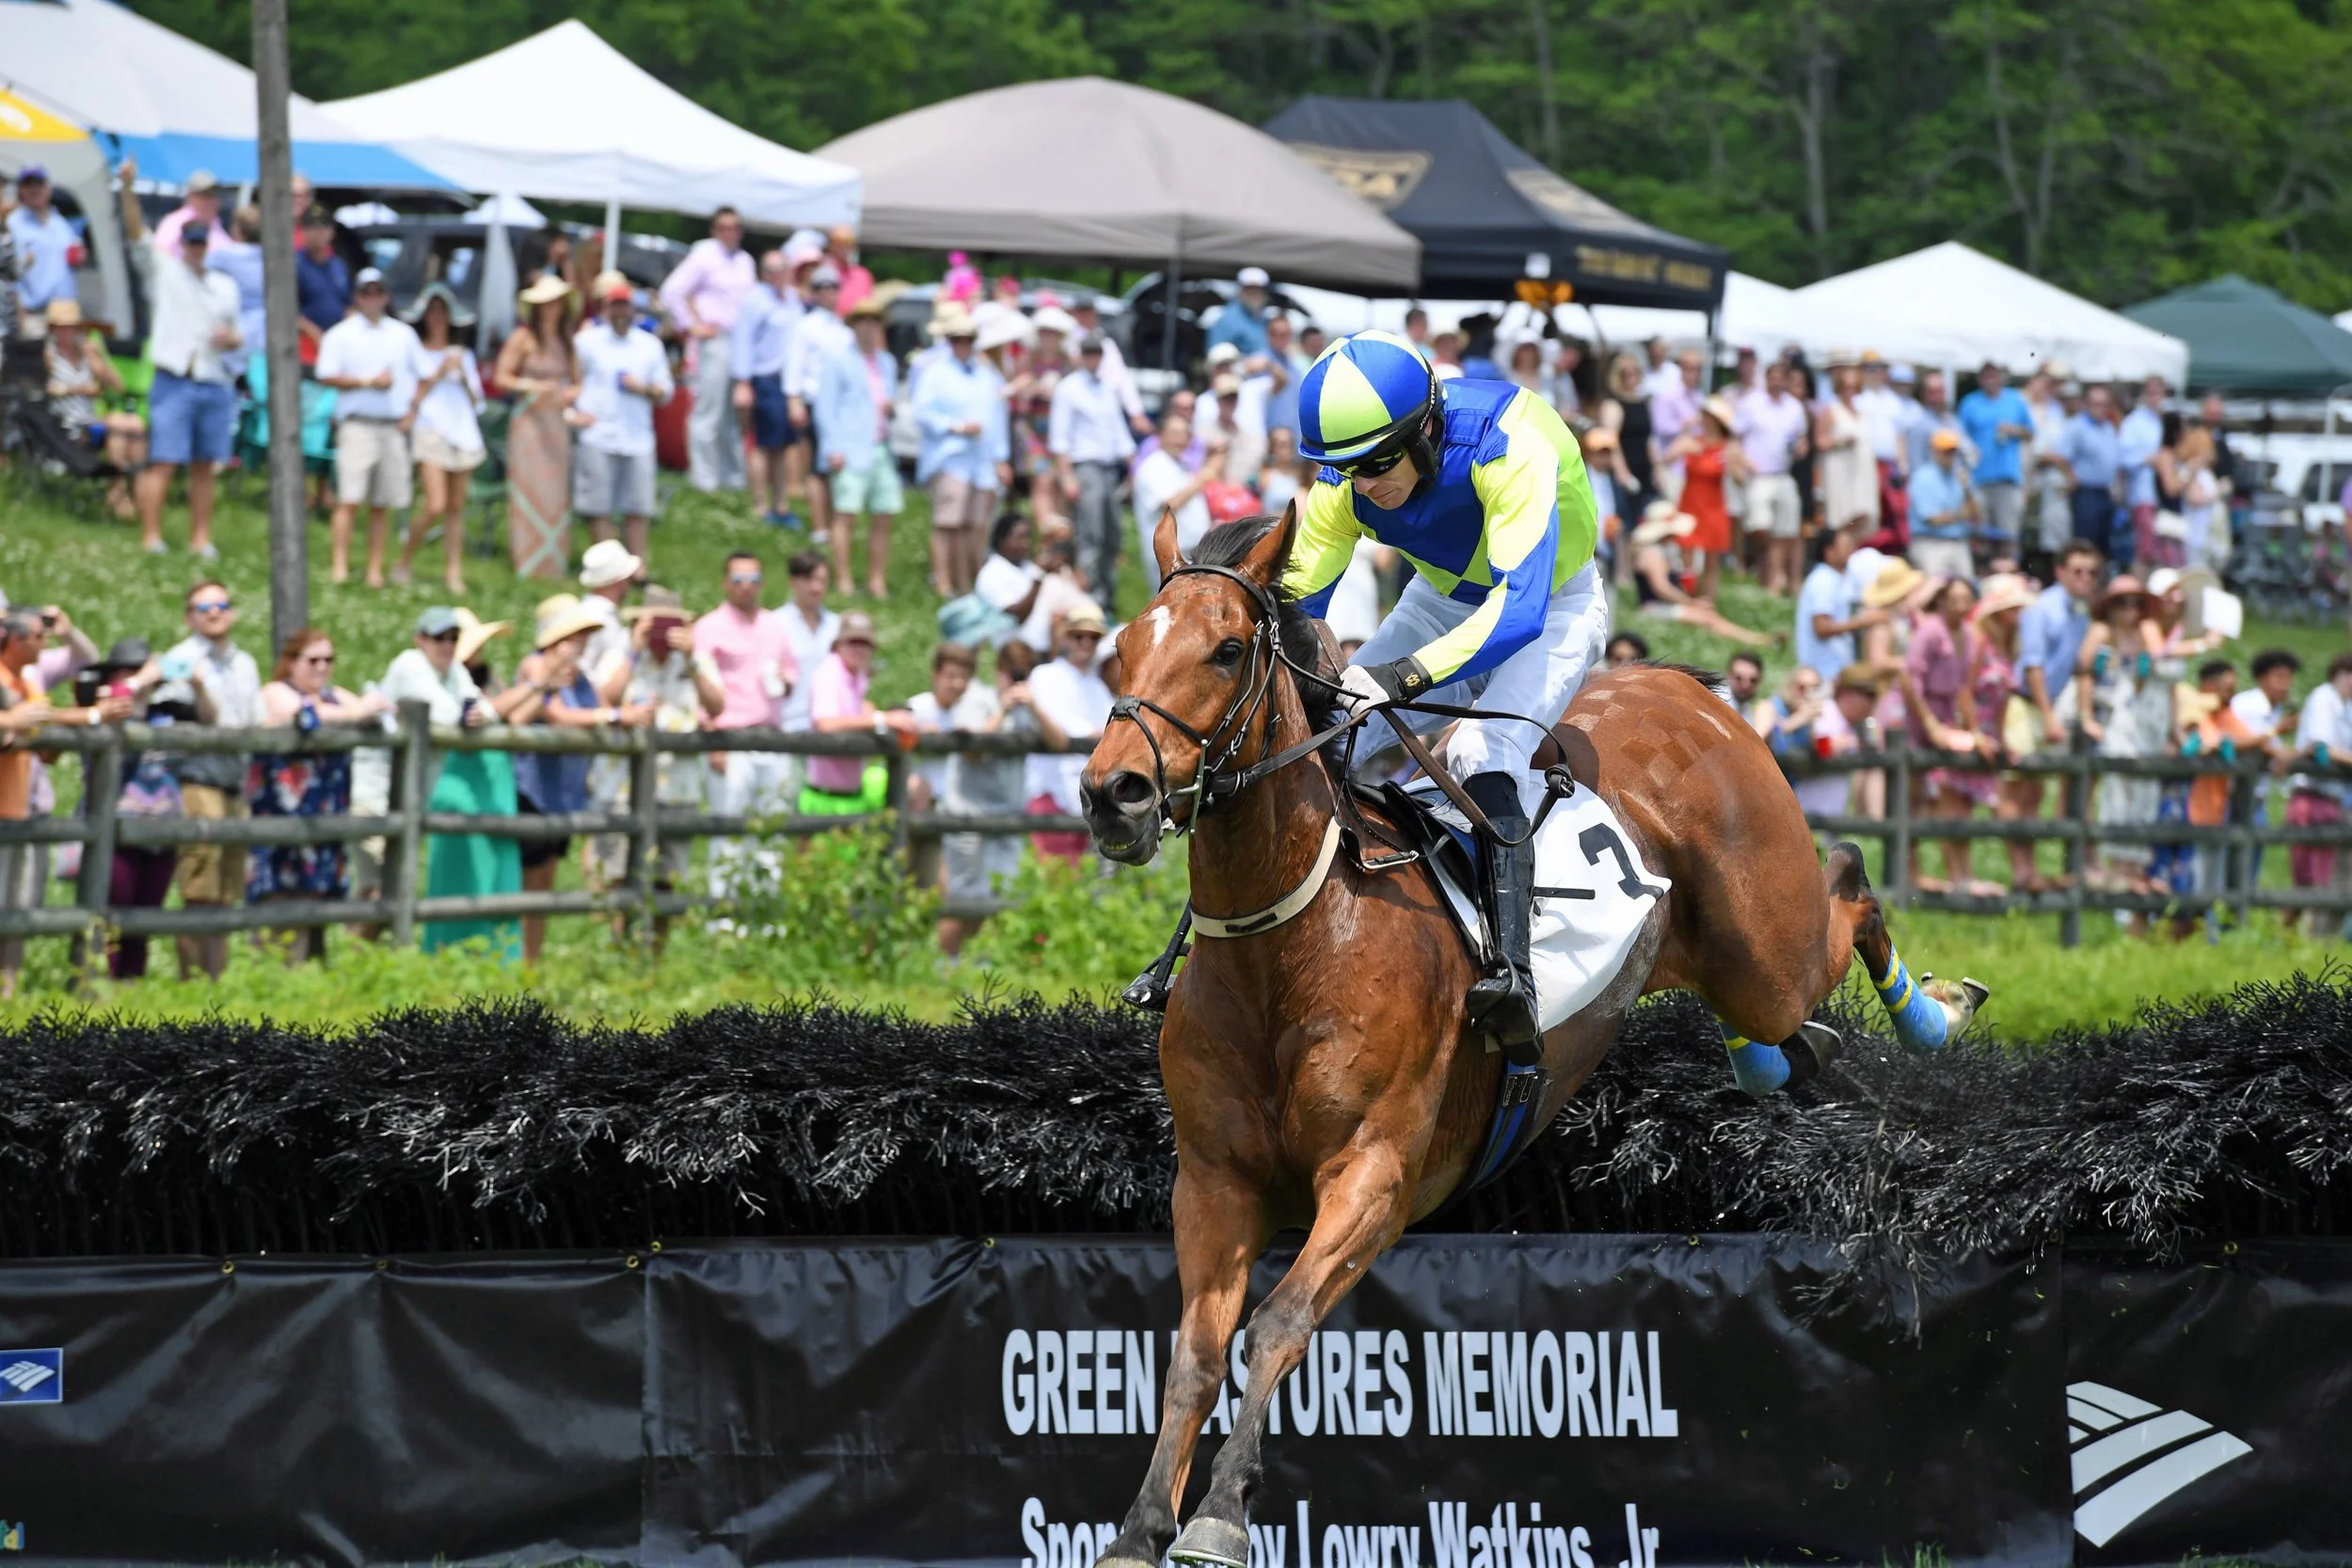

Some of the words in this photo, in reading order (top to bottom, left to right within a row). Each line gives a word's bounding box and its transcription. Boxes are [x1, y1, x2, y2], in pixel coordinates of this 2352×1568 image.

[1001, 1328, 1157, 1436] GREEN
[1170, 1328, 1413, 1437] ASURES
[1423, 1329, 1679, 1438] MEMORIAL
[1427, 1500, 1596, 1568] Watkins
